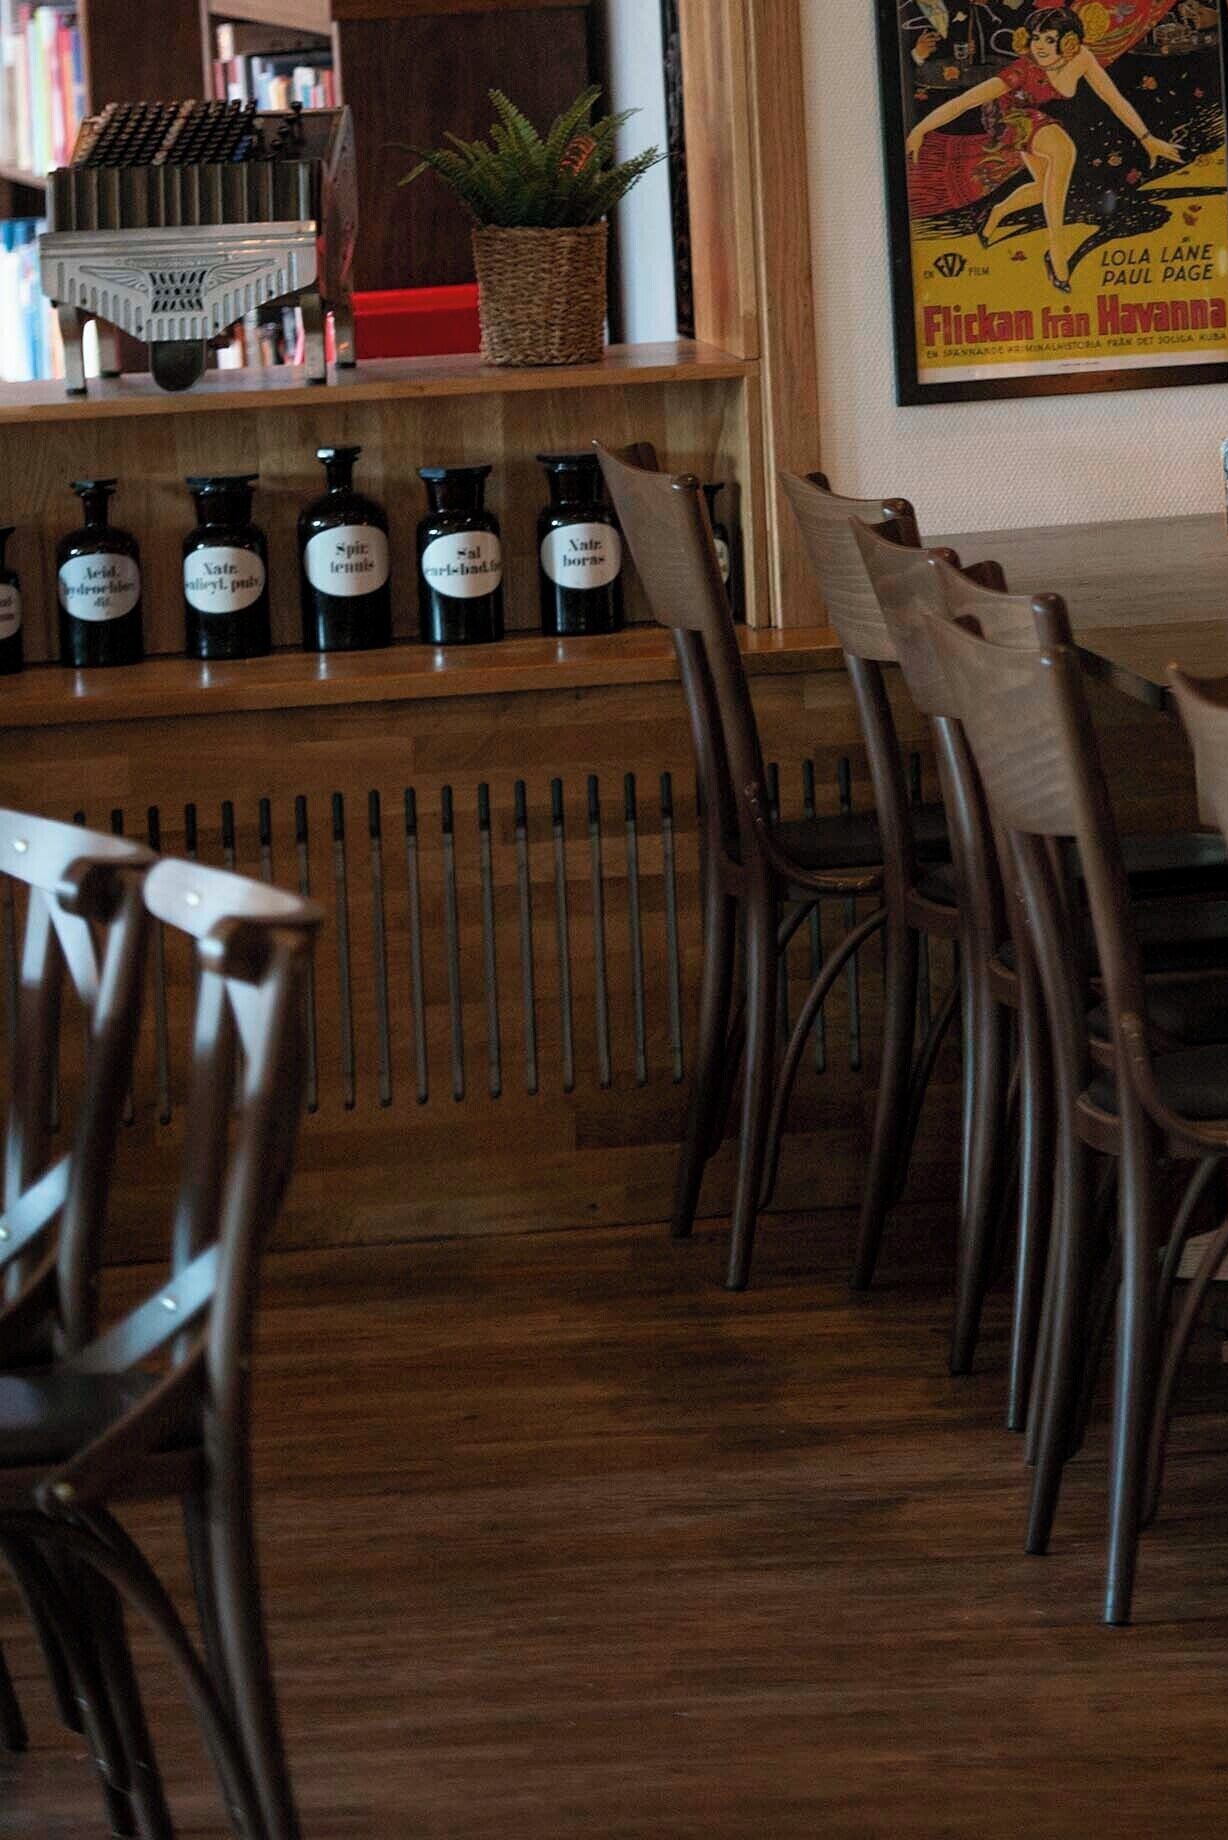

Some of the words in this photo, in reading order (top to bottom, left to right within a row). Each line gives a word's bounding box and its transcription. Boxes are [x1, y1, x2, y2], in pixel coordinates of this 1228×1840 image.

[1101, 247, 1151, 267] LOLA
[1160, 243, 1214, 263] LANE
[1102, 267, 1153, 287] PAUL
[1162, 263, 1214, 282] PAGE
[922, 305, 1034, 347] Flickan
[1041, 305, 1091, 339] från
[1096, 293, 1228, 336] Havanna
[457, 545, 481, 560] Sal
